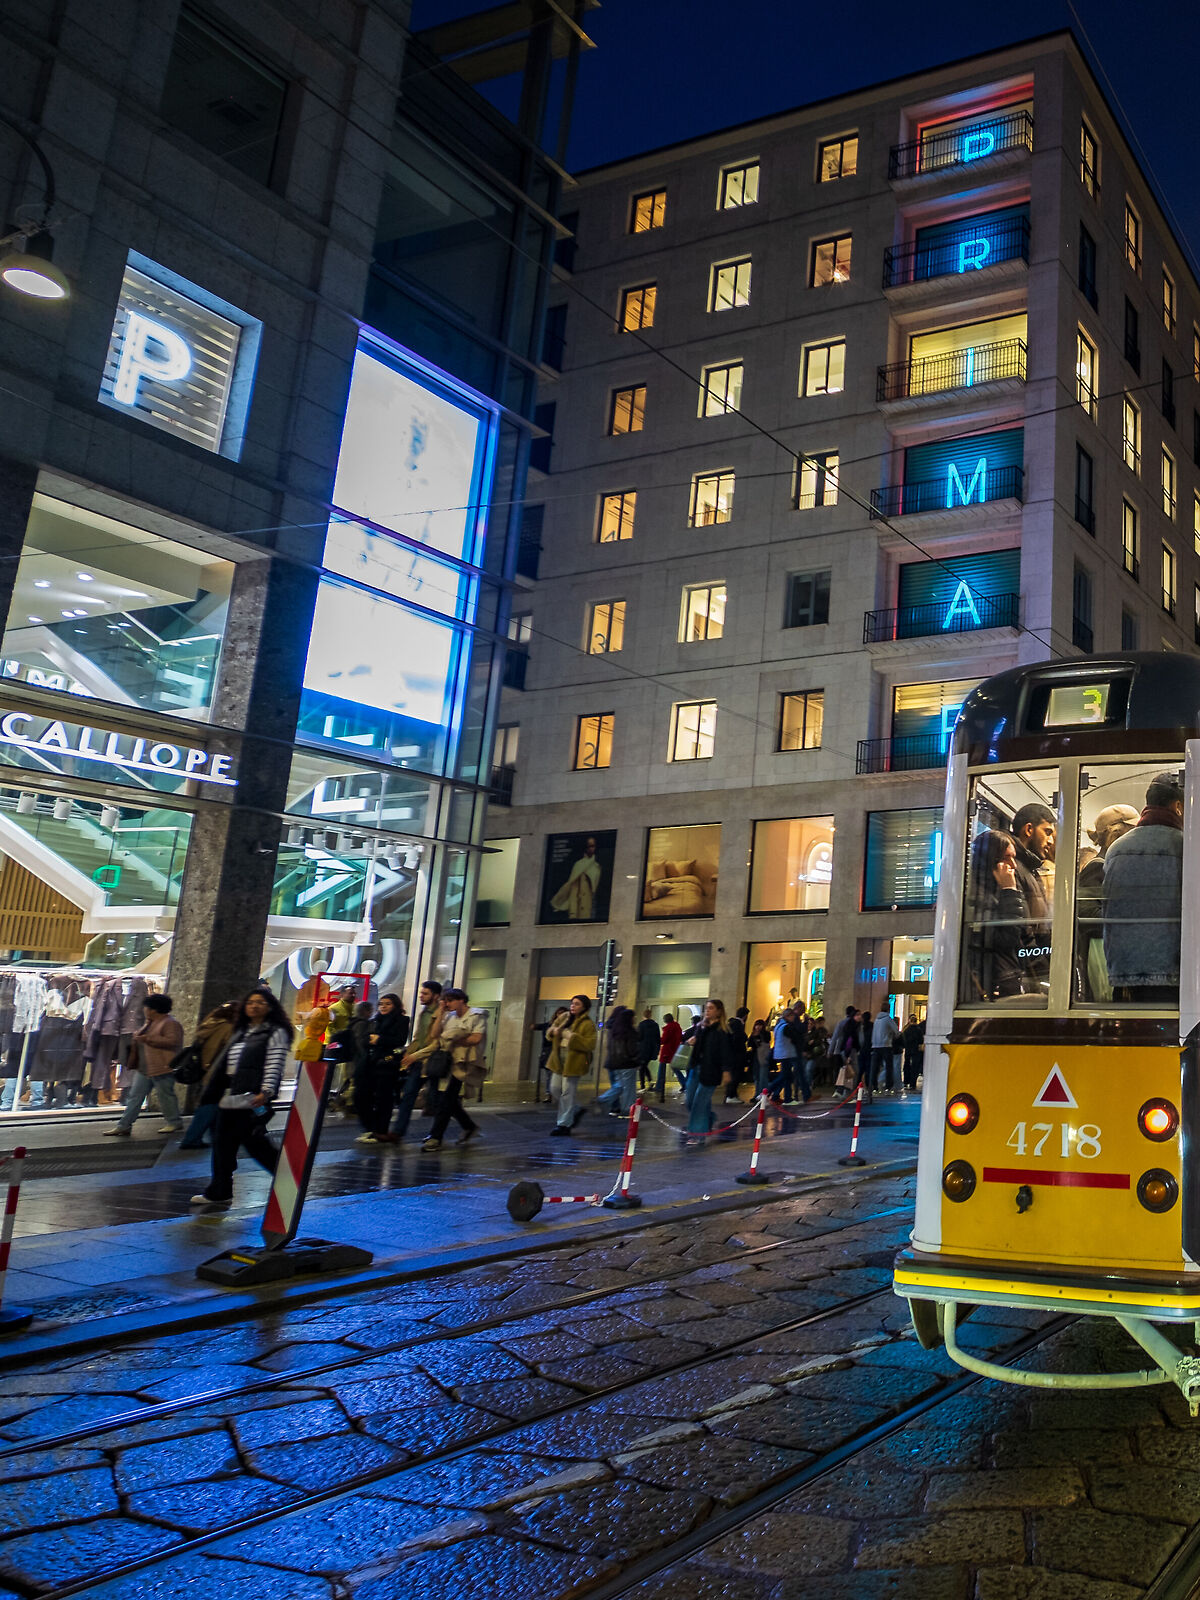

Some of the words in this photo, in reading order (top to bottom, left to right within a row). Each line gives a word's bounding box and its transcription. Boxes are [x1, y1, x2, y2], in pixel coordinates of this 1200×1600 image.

[1081, 689, 1102, 722] 3
[1, 712, 233, 780] CALLIOPE
[1006, 1121, 1101, 1159] 4718
